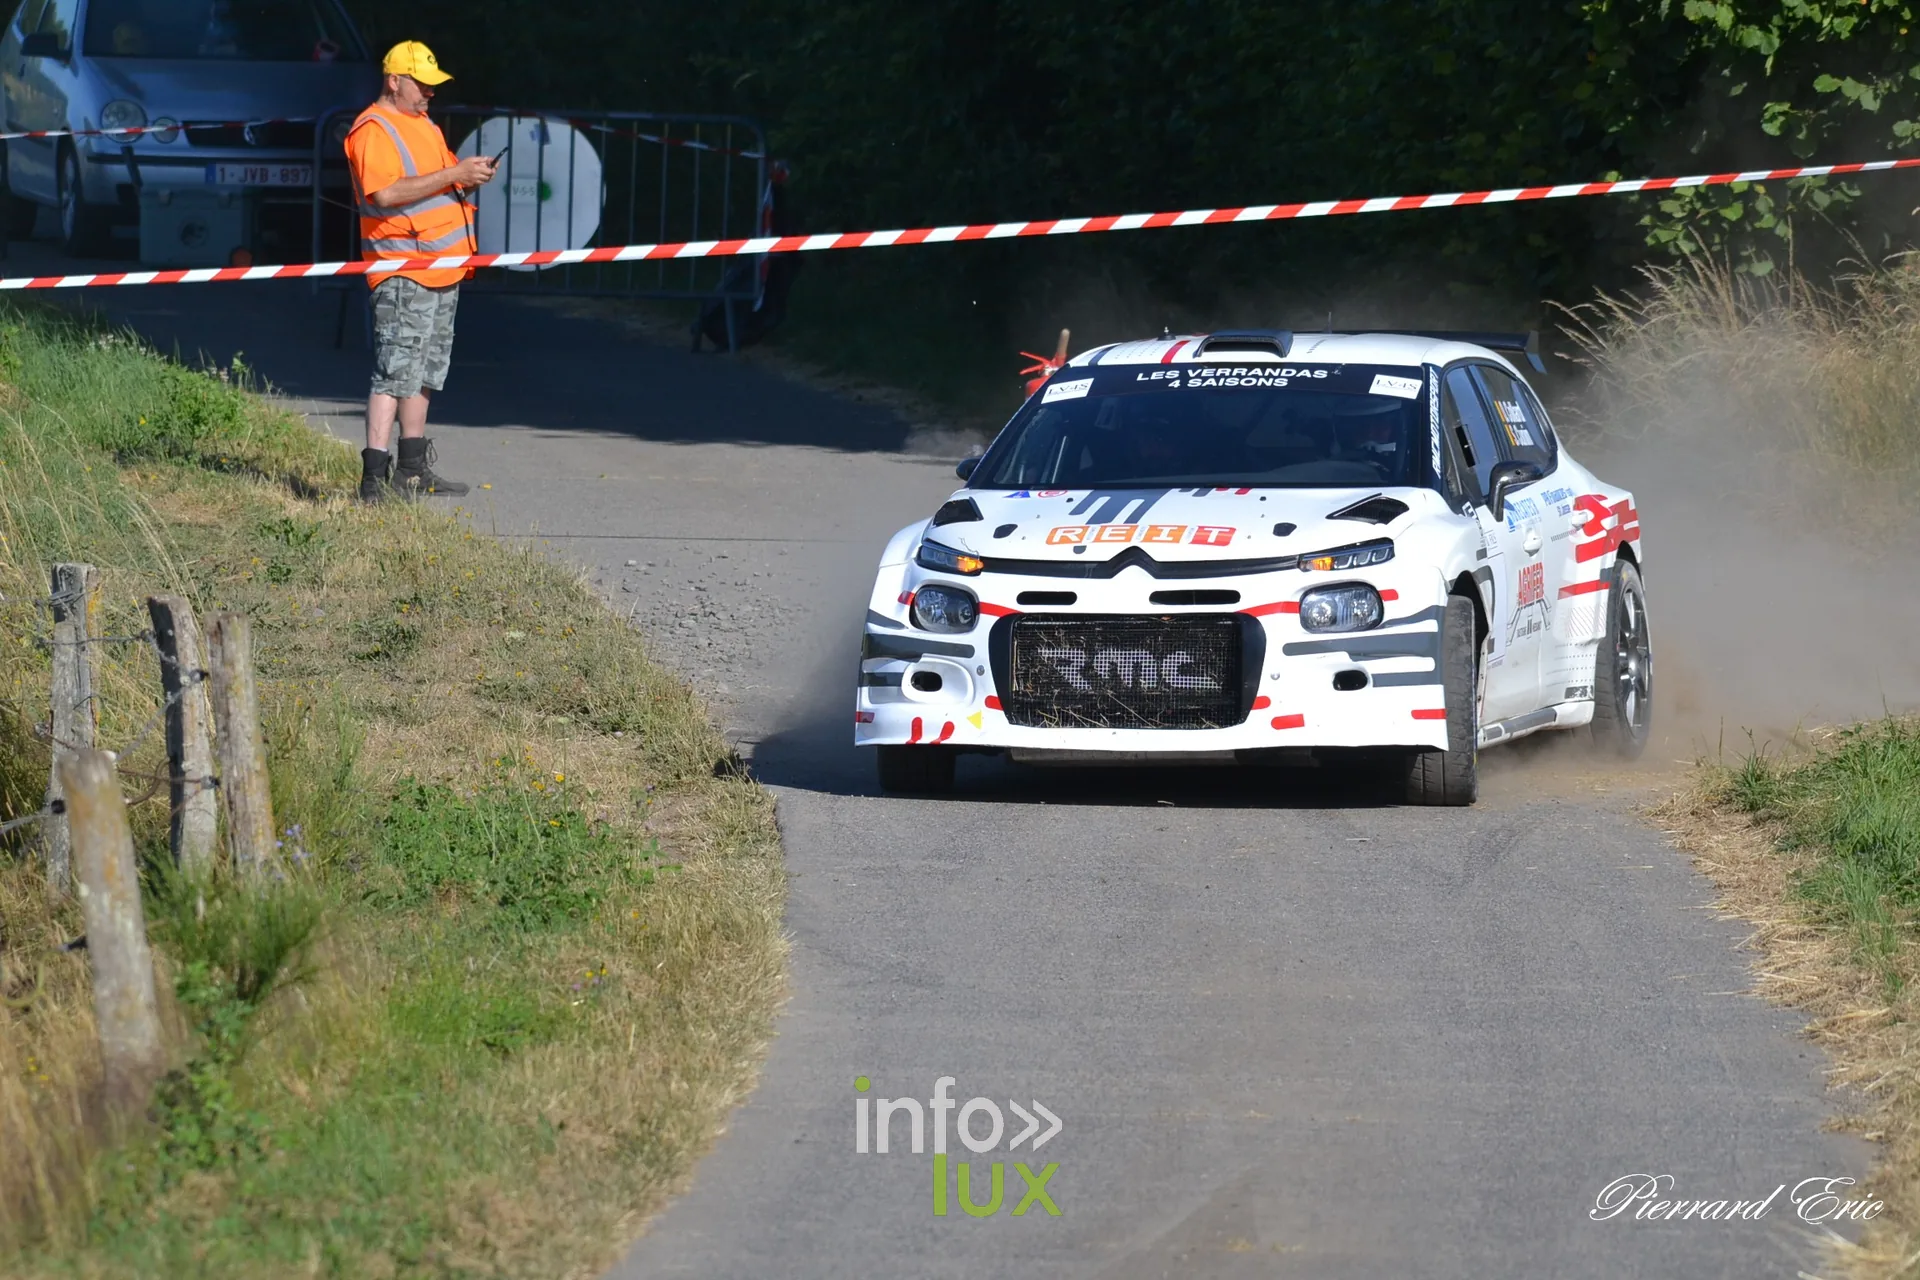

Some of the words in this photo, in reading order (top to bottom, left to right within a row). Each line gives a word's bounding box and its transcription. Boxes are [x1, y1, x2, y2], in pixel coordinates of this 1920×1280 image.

[1136, 370, 1180, 381] LES
[1187, 367, 1328, 379] VERRANDAS
[1167, 378, 1181, 388] 4
[1187, 377, 1289, 388] SAISONS
[1051, 526, 1234, 544] REIT
[1517, 561, 1545, 606] AGRIFER
